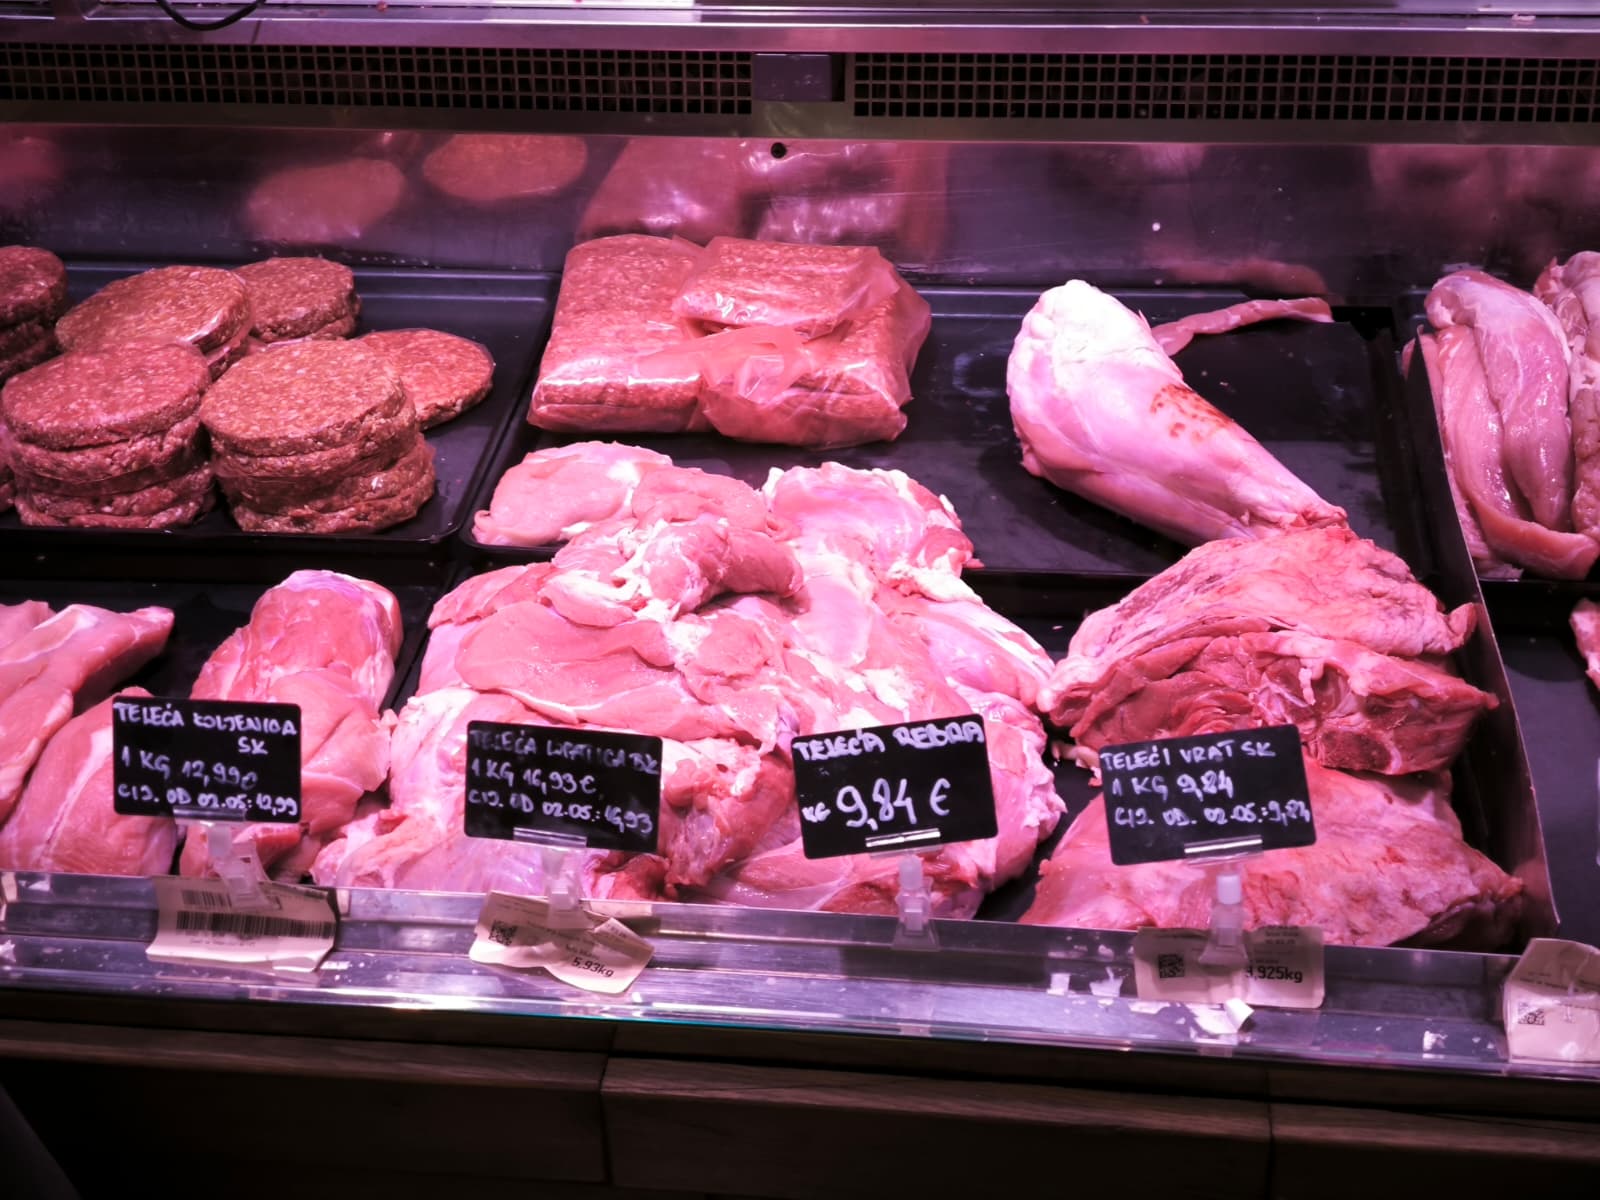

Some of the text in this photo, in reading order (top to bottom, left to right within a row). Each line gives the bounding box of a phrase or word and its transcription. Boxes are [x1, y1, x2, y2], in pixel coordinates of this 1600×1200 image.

[122, 746, 130, 767] 1
[140, 750, 170, 779] KG
[1180, 740, 1235, 763] VRAT
[1241, 741, 1276, 756] SK
[472, 758, 480, 776] 1
[487, 760, 514, 786] KG
[166, 787, 191, 804] OD
[1112, 778, 1122, 796] 1
[1131, 776, 1168, 801] KG
[836, 778, 917, 830] 9,84
[930, 778, 951, 816] €
[572, 957, 614, 978] 5,93kg
